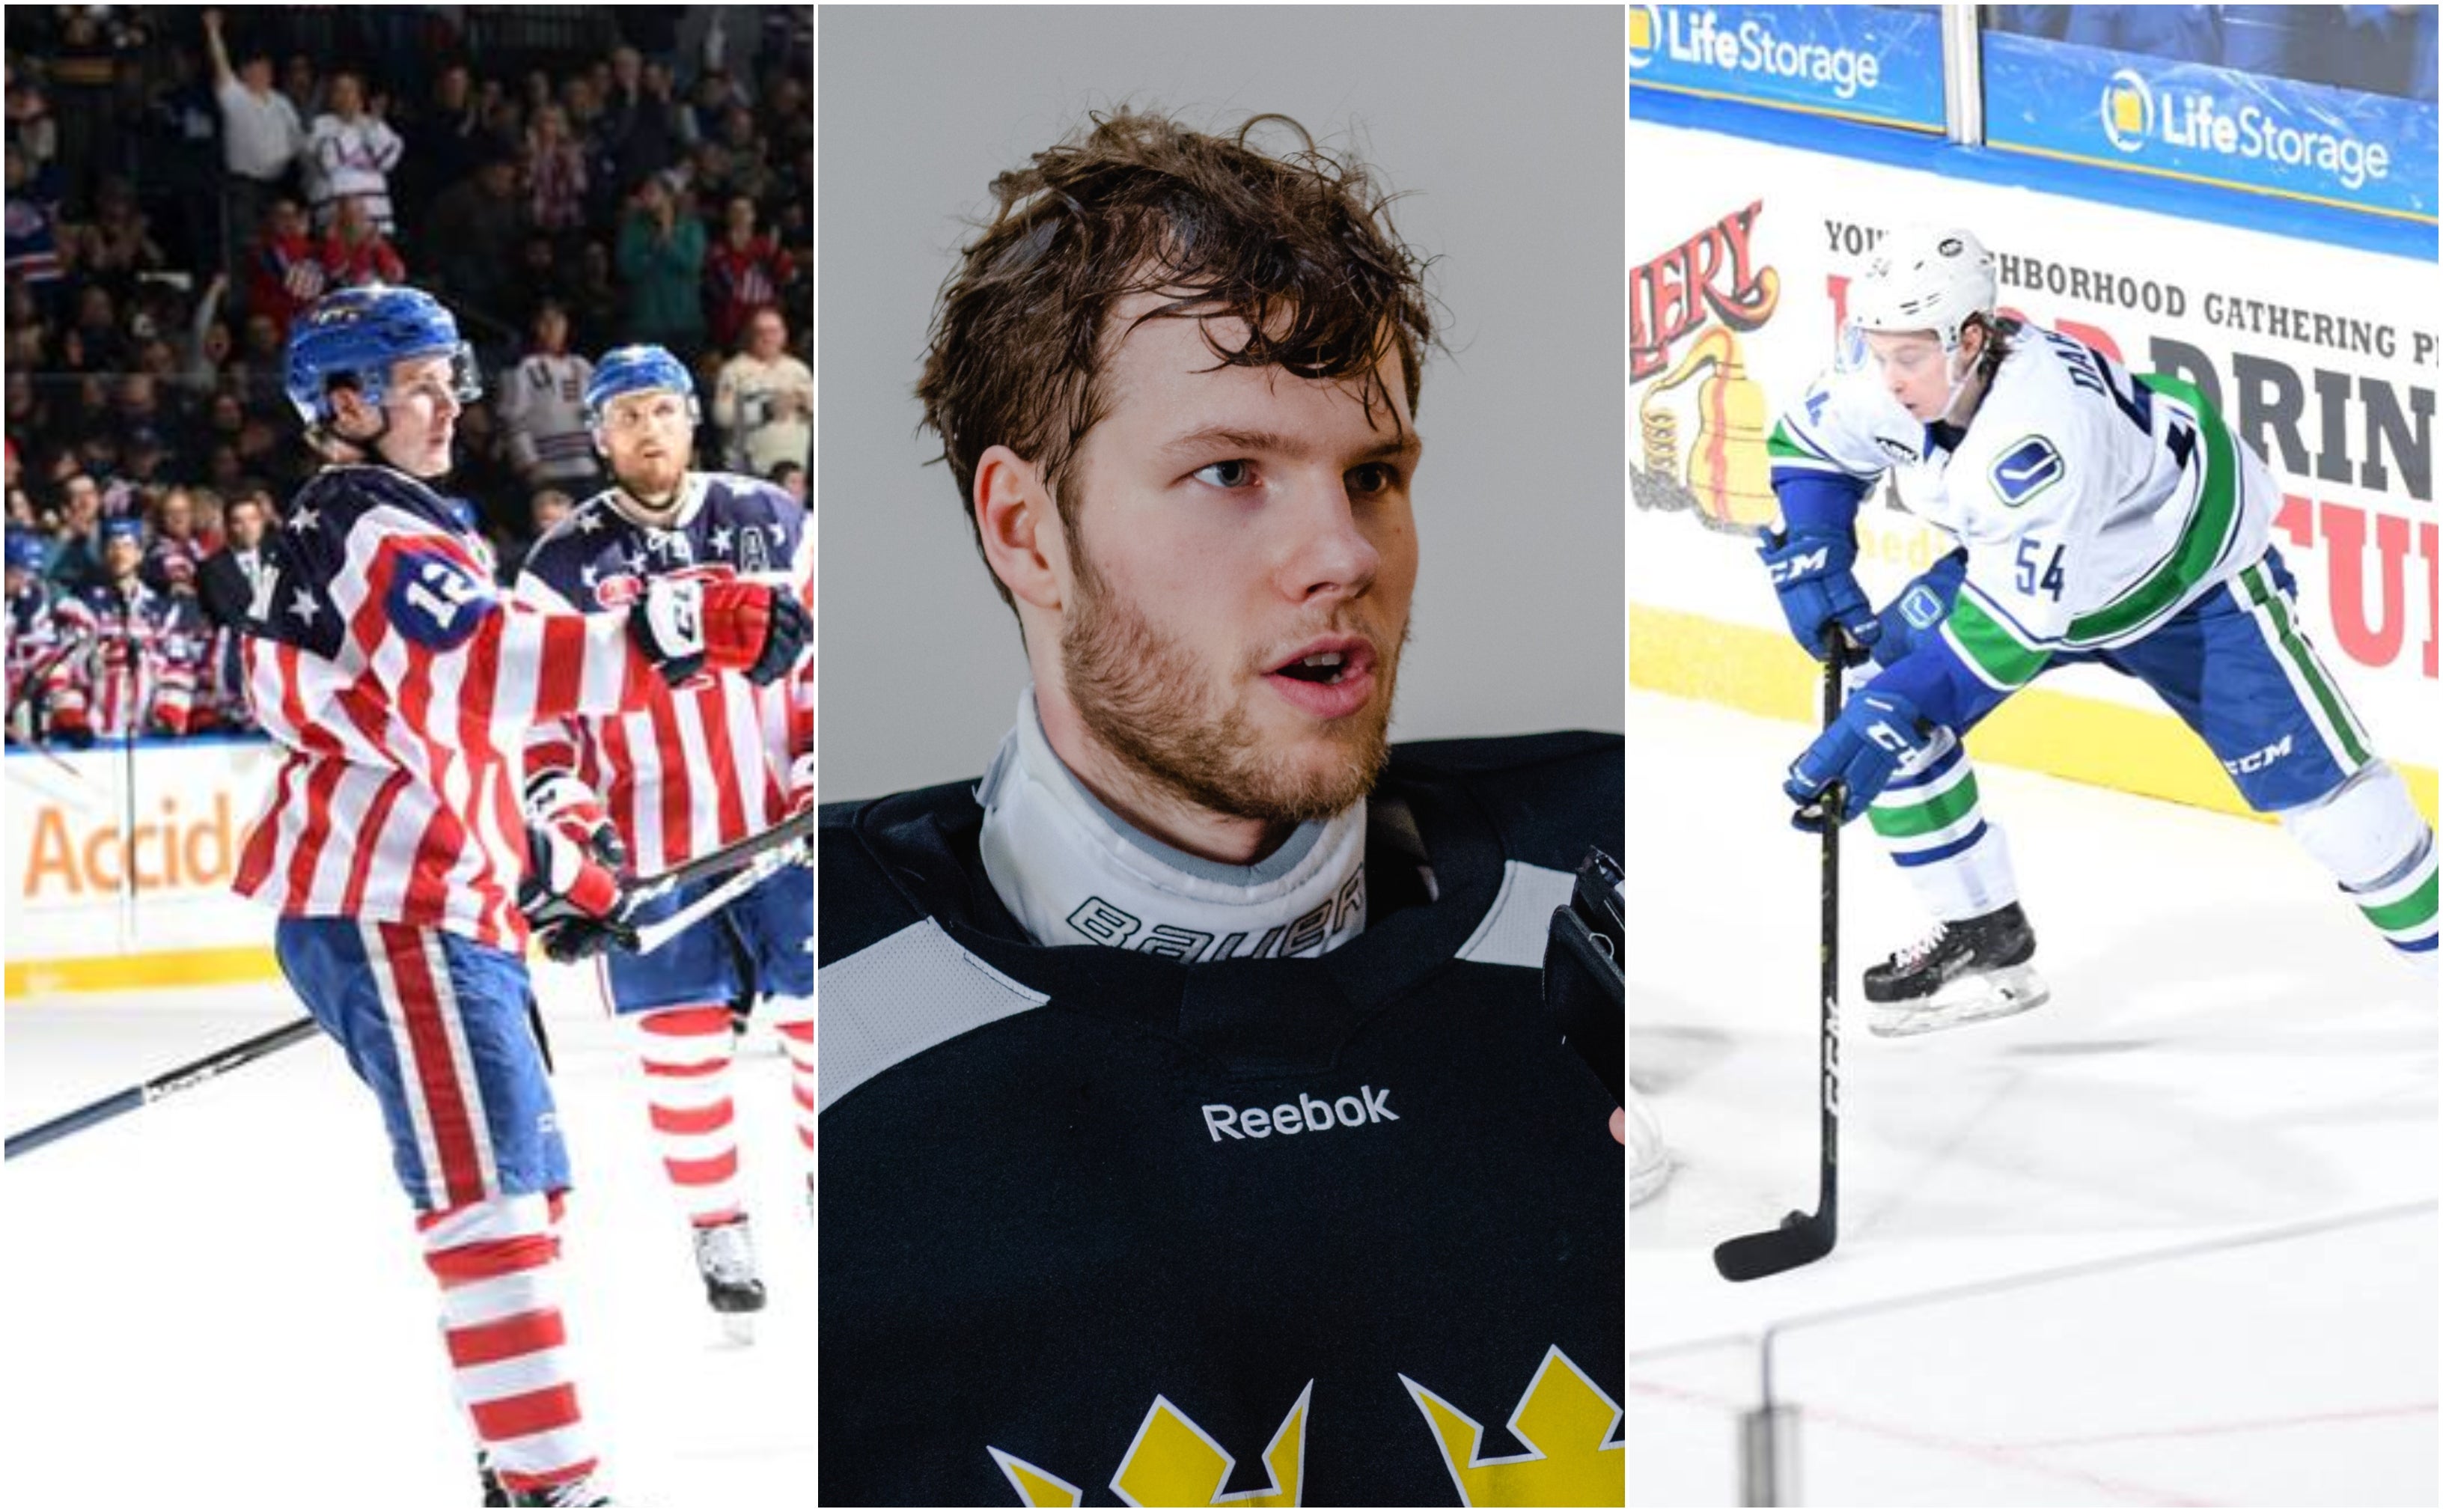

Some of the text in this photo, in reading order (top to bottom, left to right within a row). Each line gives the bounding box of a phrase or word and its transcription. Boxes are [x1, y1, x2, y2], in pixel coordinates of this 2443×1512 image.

[2203, 293, 2396, 359] GATHERING
[2412, 331, 2439, 368] P
[2015, 537, 2067, 602] 54
[24, 790, 253, 898] Accid
[1201, 1085, 1400, 1142] Reebok
